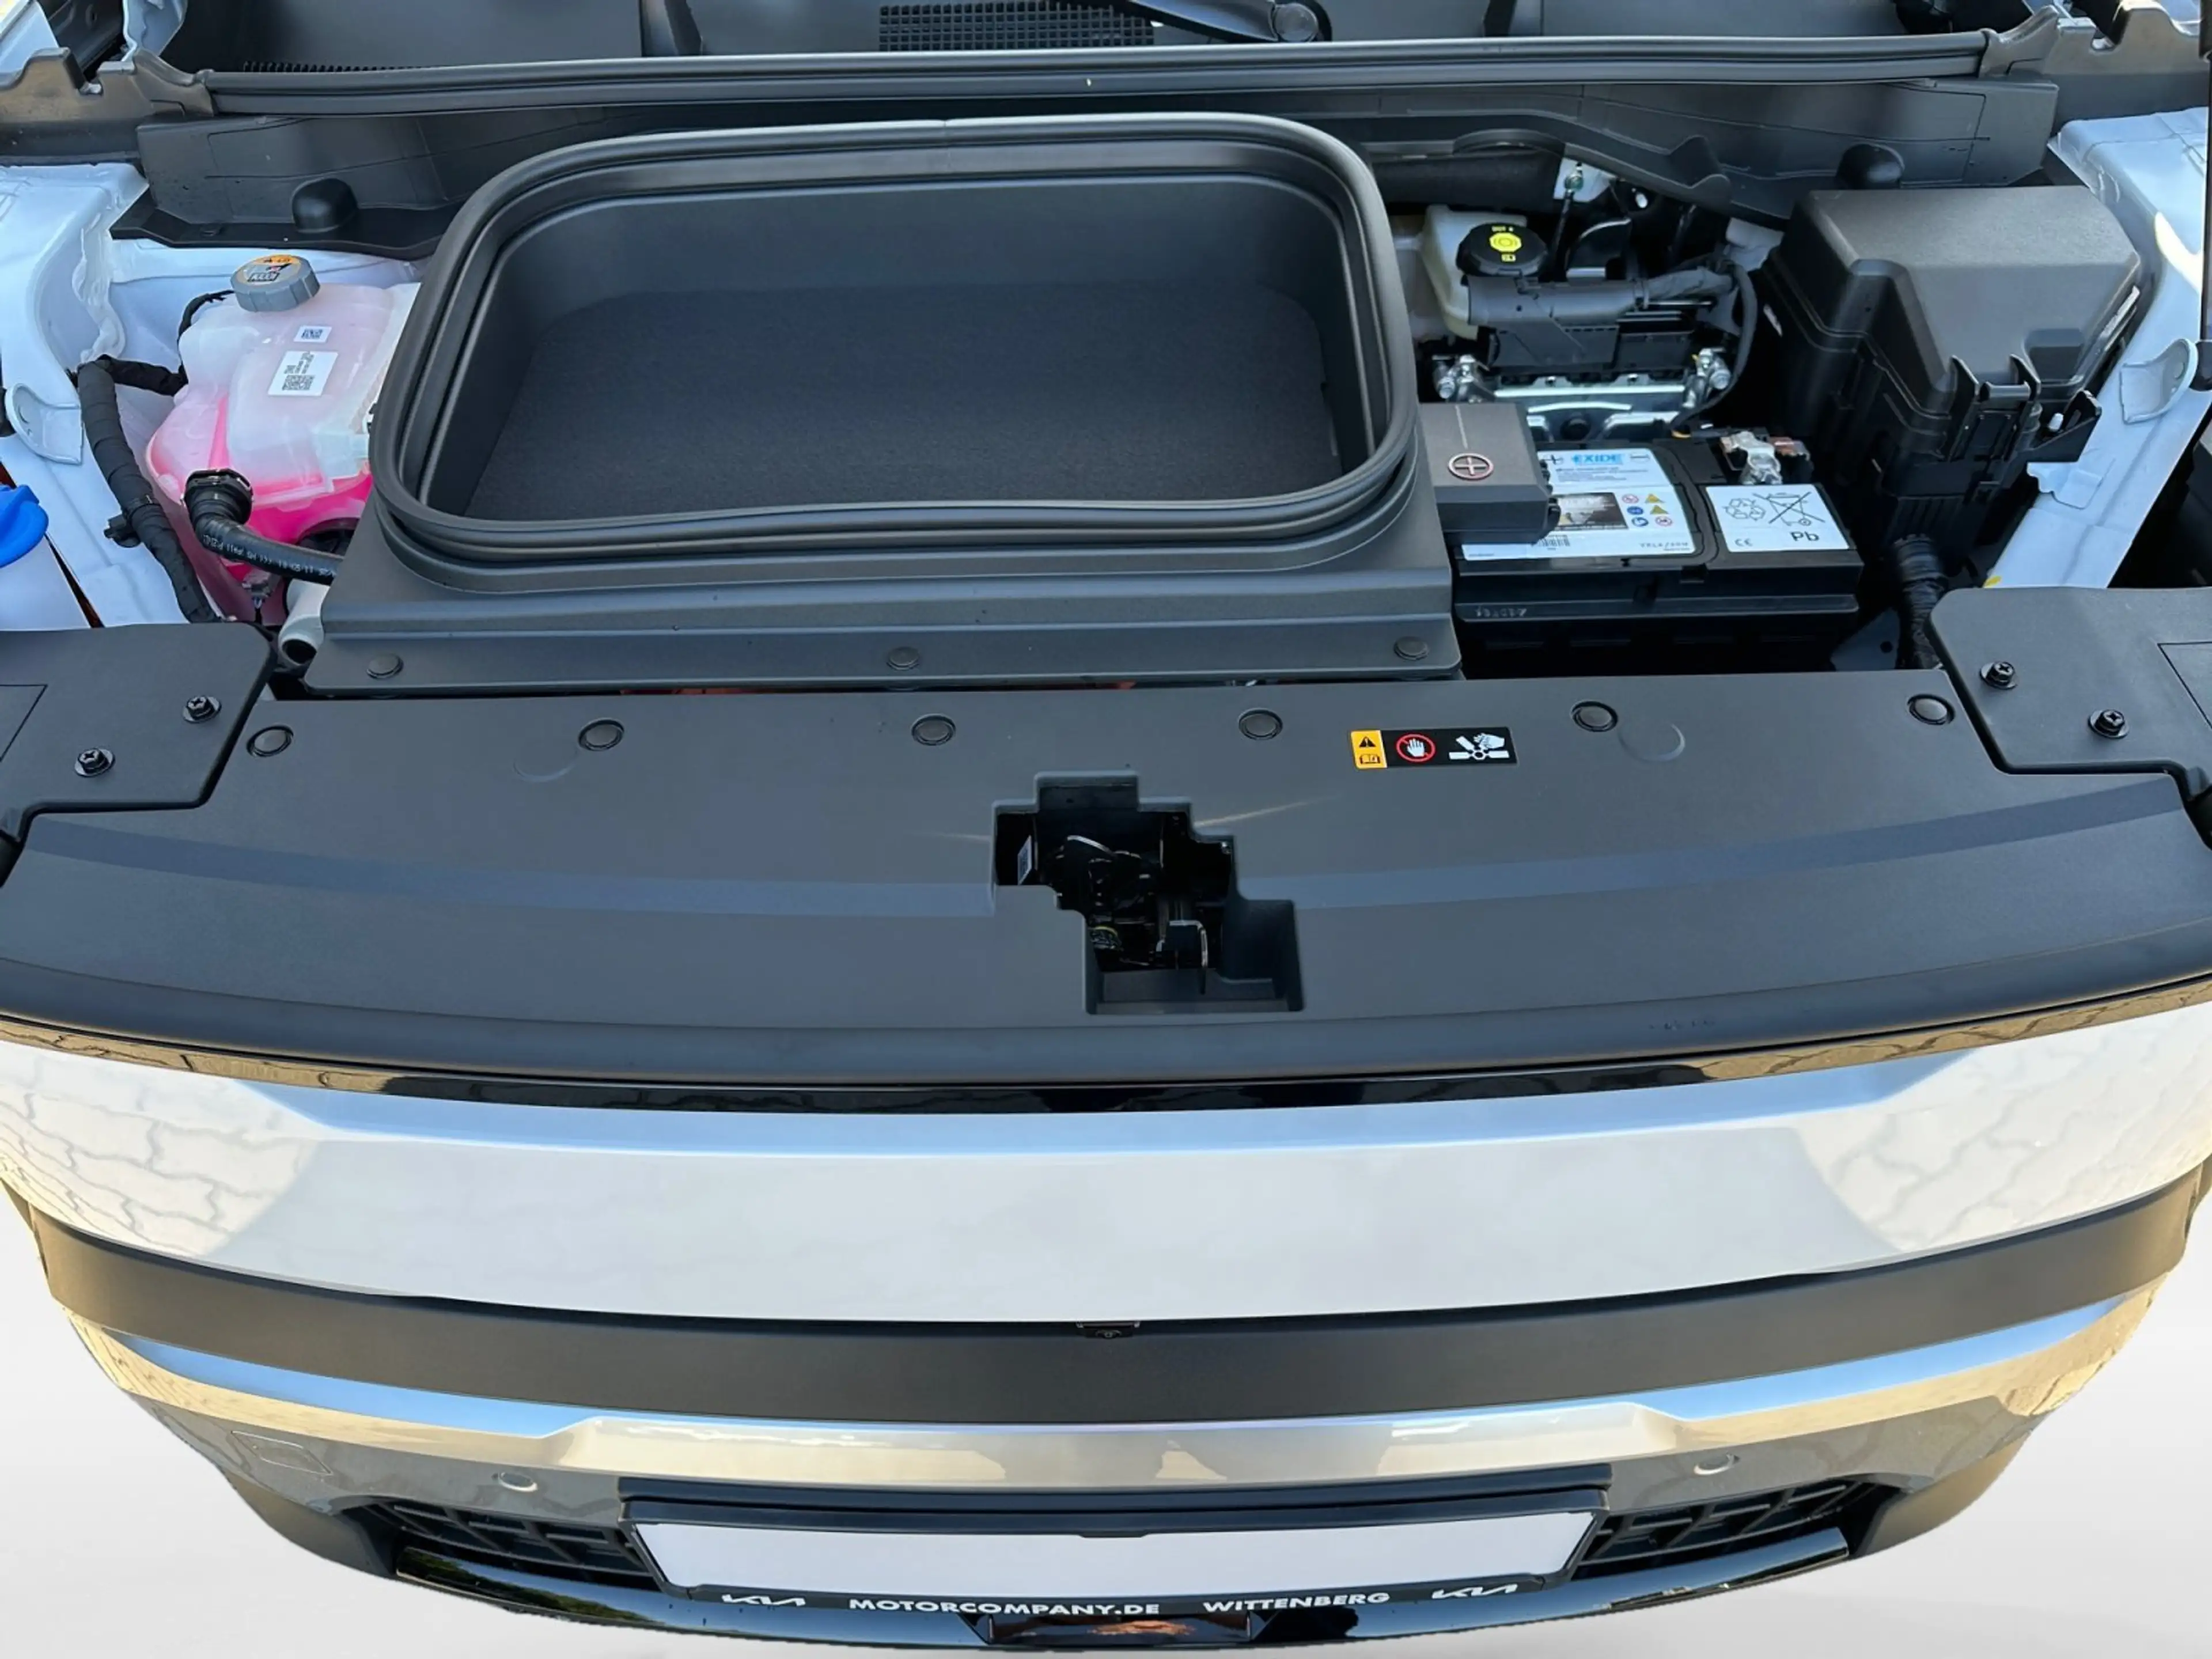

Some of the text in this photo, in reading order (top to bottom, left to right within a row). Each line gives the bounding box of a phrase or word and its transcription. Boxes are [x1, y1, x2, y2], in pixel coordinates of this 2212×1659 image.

[1572, 453, 1623, 463] EXIDE
[1790, 531, 1819, 541] Pb
[722, 1584, 1518, 1615] KIA MOTORCOMPANY.DE WITTENBERG KIA
